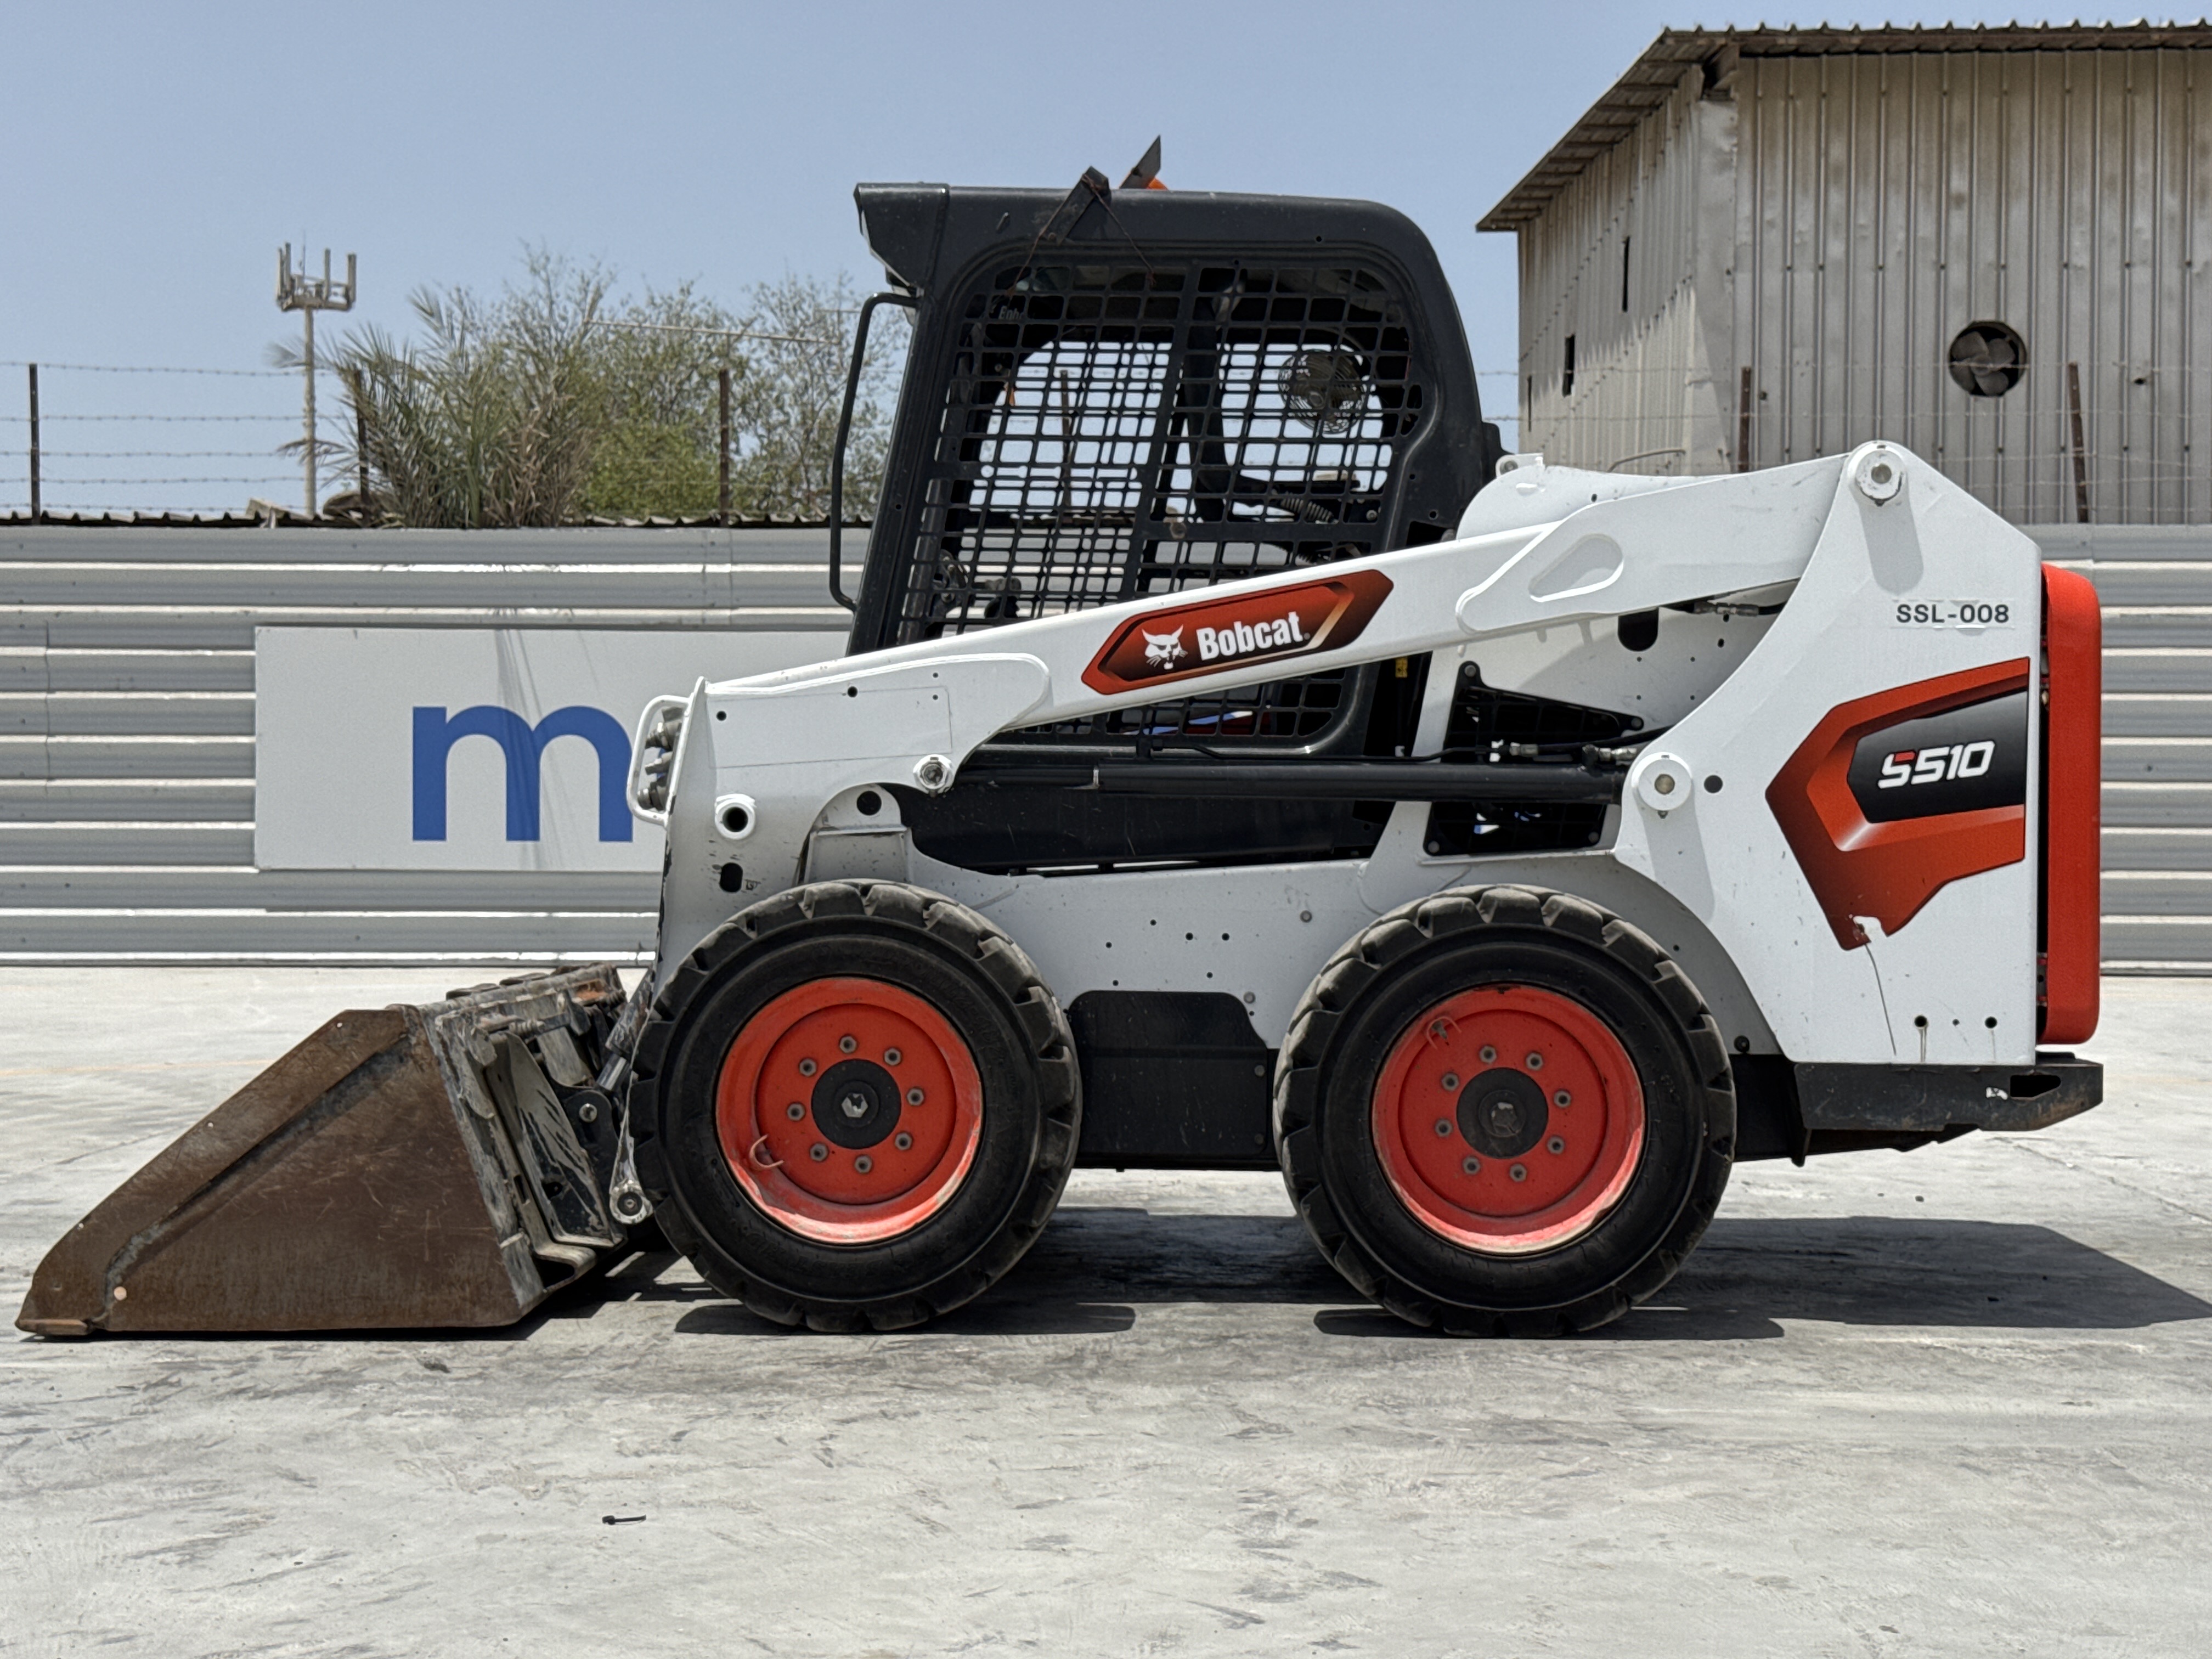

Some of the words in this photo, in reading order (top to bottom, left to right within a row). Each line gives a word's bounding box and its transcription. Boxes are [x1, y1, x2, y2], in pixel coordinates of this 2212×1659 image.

[1196, 611, 1304, 661] Bobcat
[1896, 603, 2010, 623] SSL-008
[413, 705, 665, 842] m
[1877, 740, 1995, 789] S510
